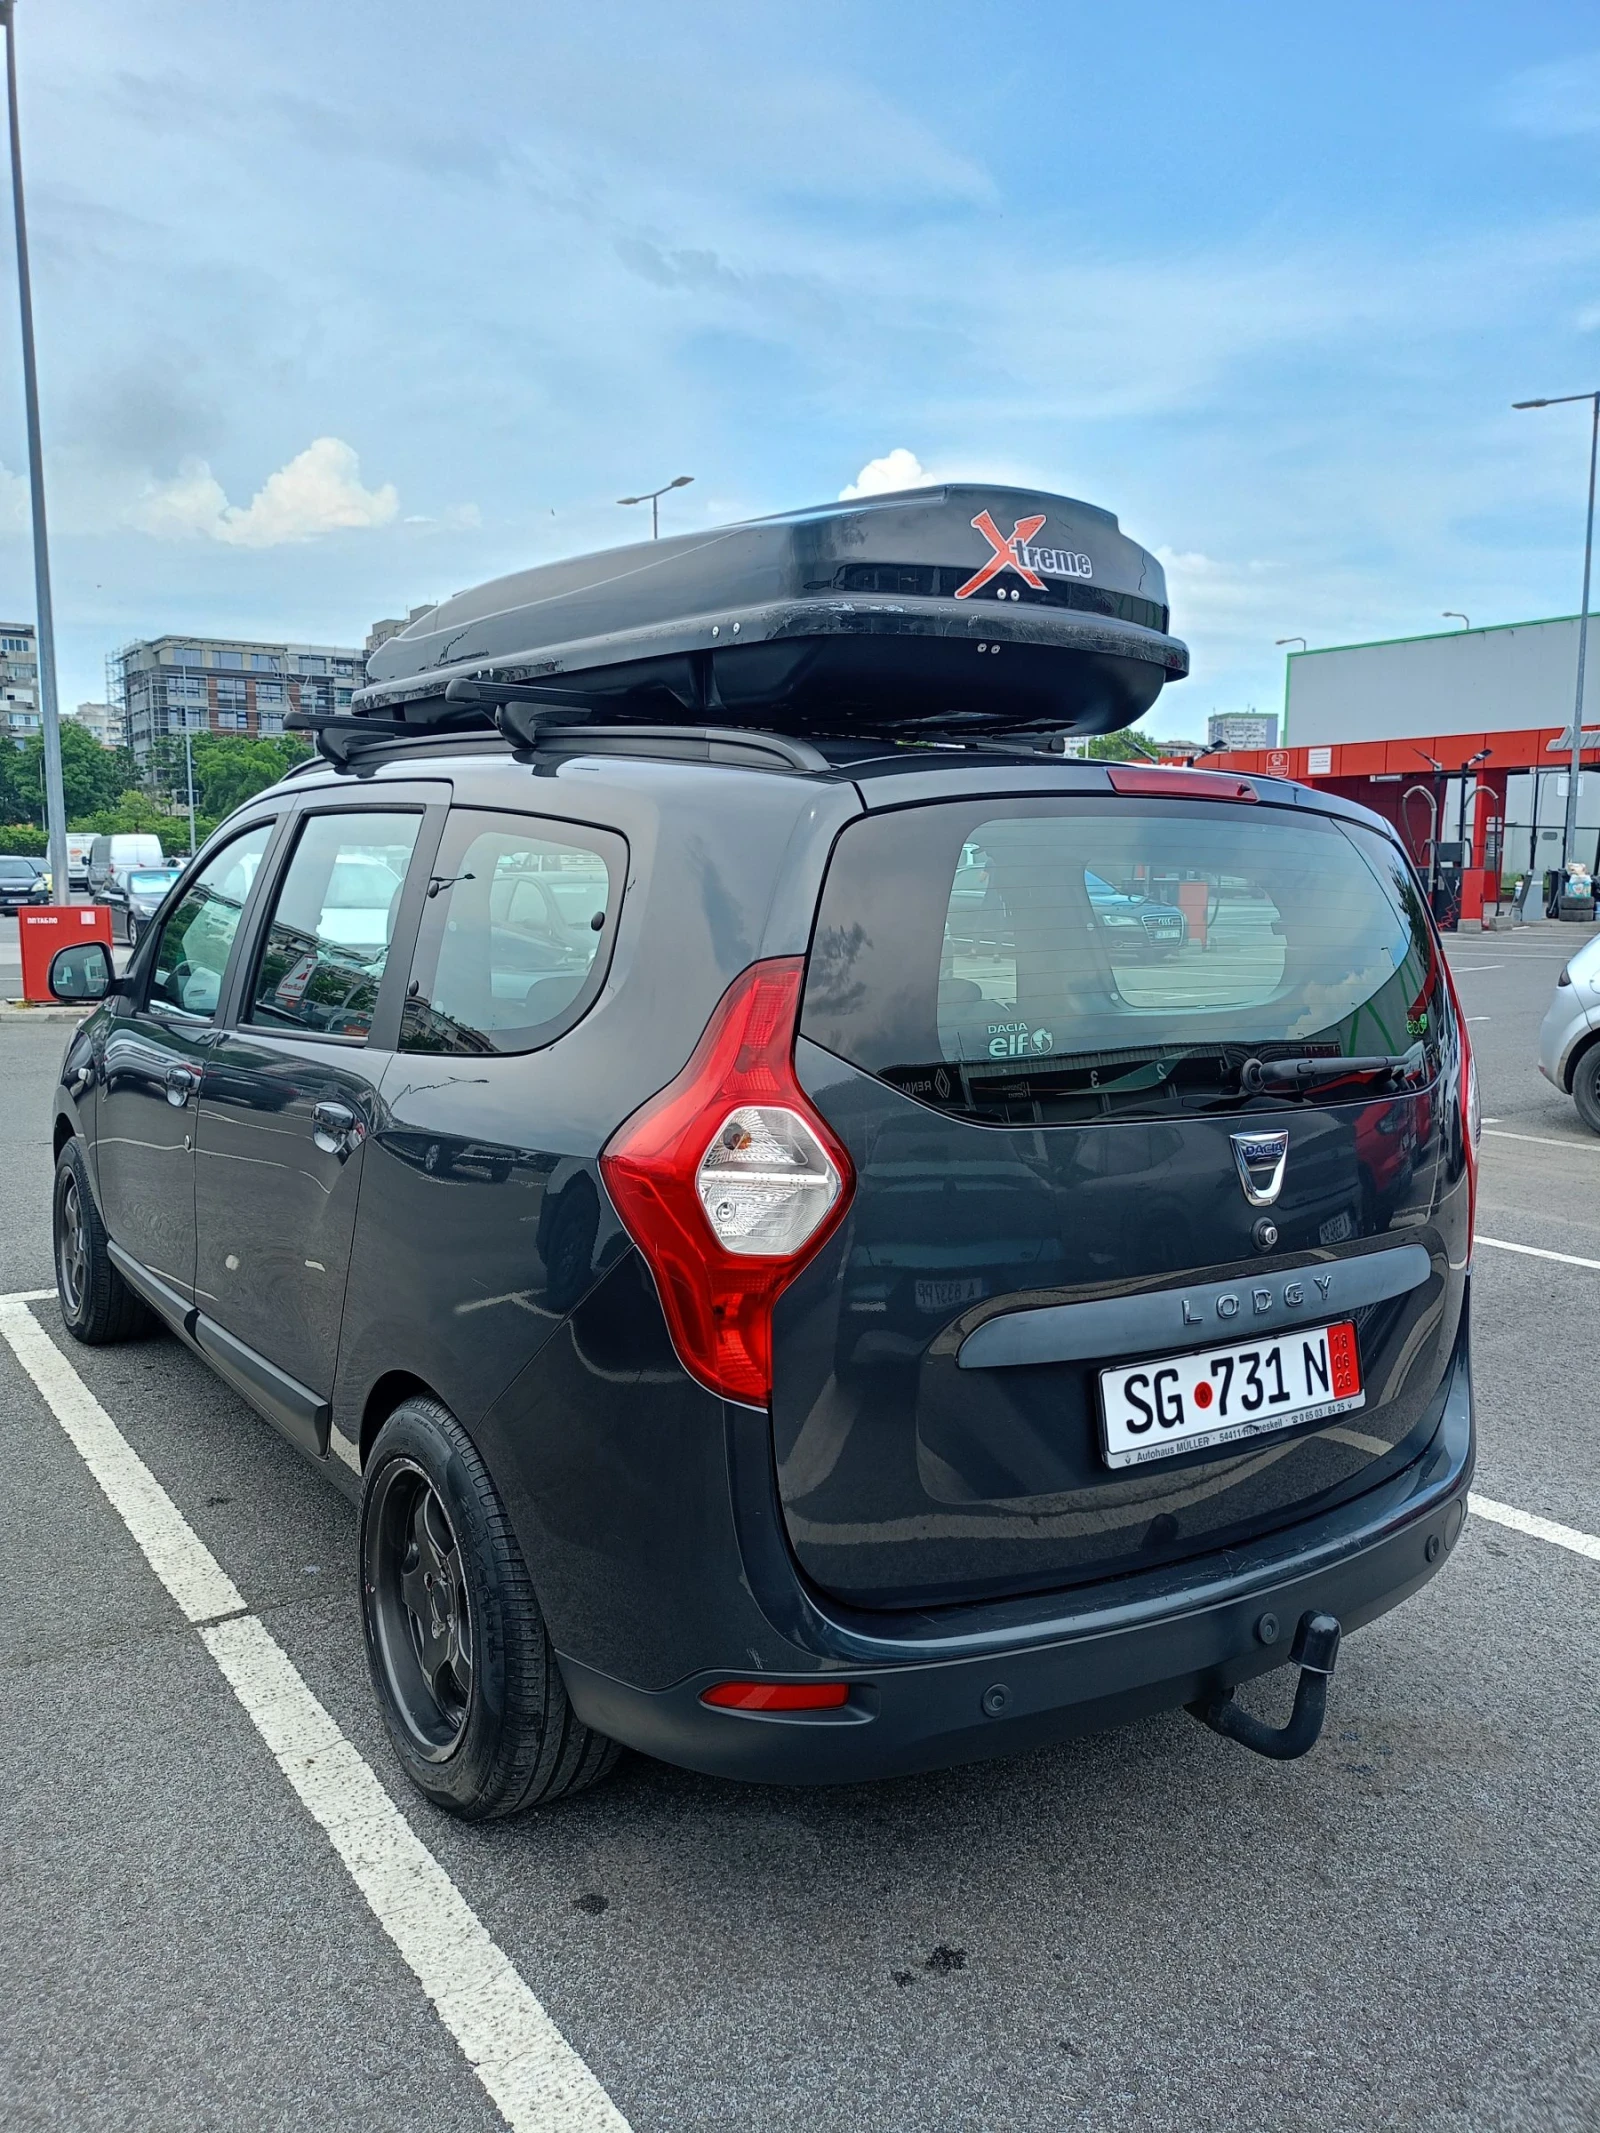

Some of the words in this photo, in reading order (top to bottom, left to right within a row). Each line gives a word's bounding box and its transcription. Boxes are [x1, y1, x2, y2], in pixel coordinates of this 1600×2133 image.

[954, 509, 1093, 600] Xtreme
[987, 1022, 1028, 1034] DACIA
[989, 1033, 1029, 1057] elf
[1246, 1142, 1283, 1156] DACIA
[1182, 1275, 1332, 1325] LODGY
[1333, 1333, 1348, 1350] 18
[1335, 1352, 1350, 1370] 06
[1124, 1368, 1184, 1434] SG
[1210, 1347, 1290, 1416] 731
[1303, 1338, 1330, 1396] N
[1136, 1446, 1175, 1462] Autohaus
[1176, 1436, 1210, 1453] MÜLLER
[1219, 1429, 1241, 1442] 54411
